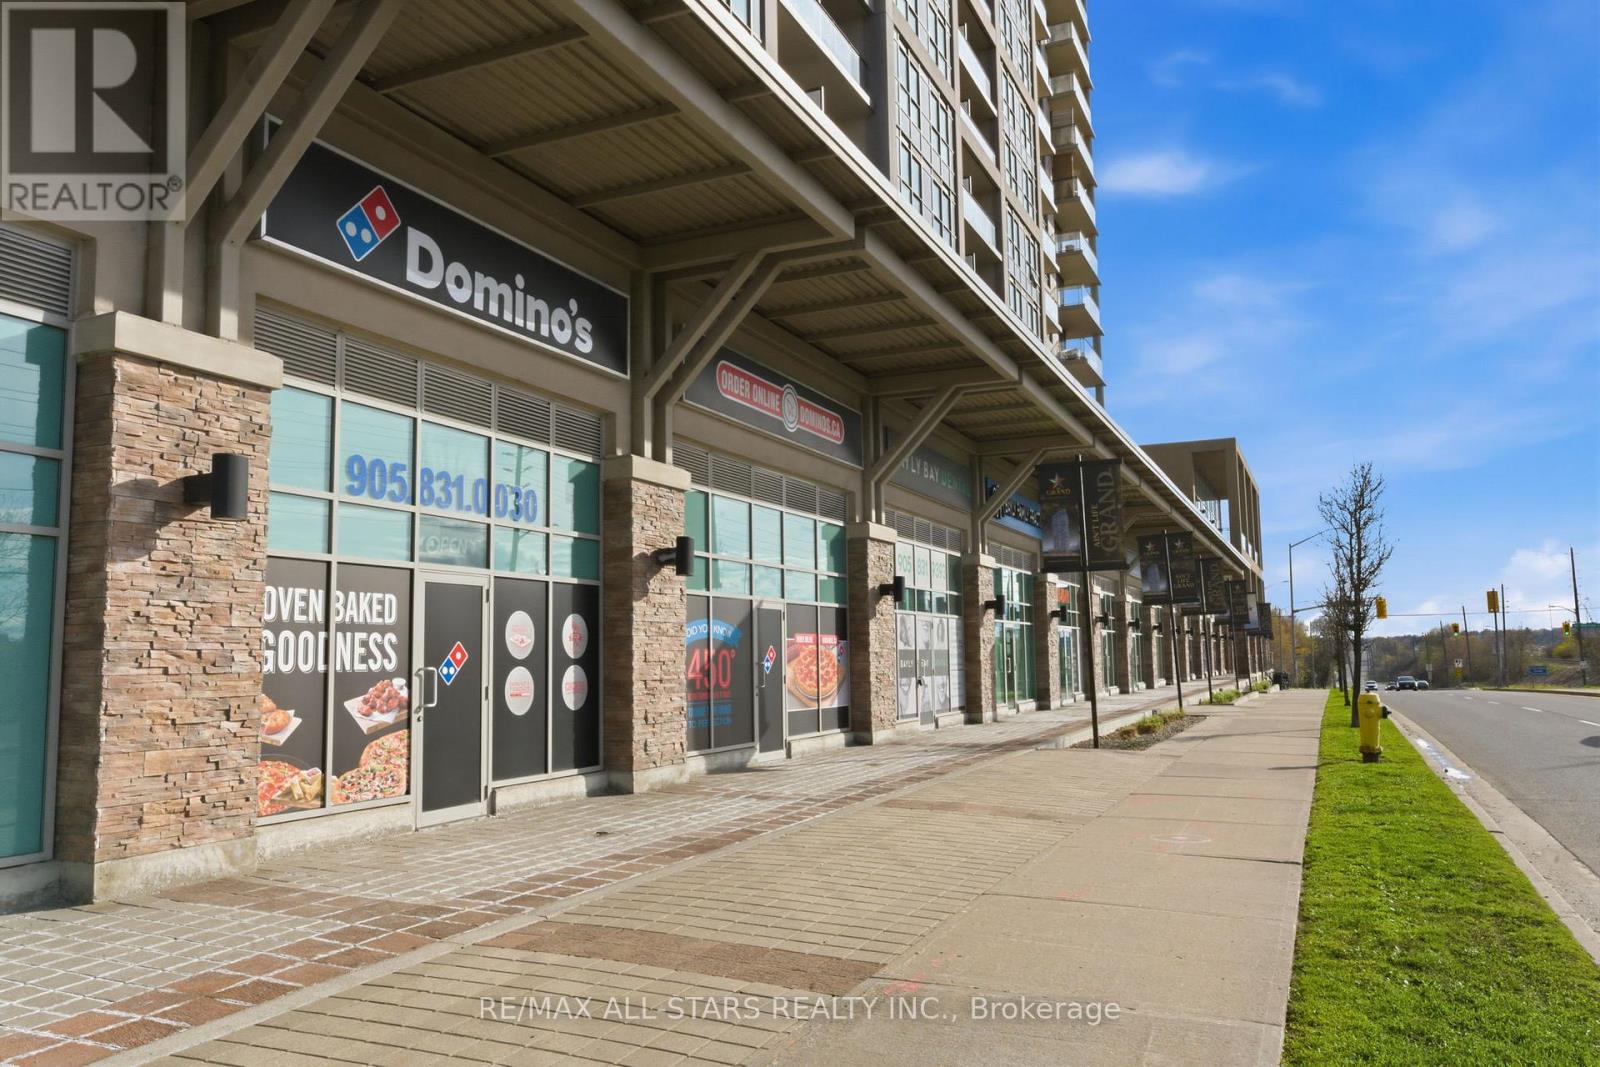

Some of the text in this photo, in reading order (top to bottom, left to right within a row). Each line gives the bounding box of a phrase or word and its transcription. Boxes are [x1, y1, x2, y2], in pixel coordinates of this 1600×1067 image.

[406, 226, 593, 353] Domino's
[721, 370, 841, 438] ORDER ONLINE DOMINOS.CA
[923, 461, 939, 483] BAY
[264, 586, 398, 625] OVEN BAKED
